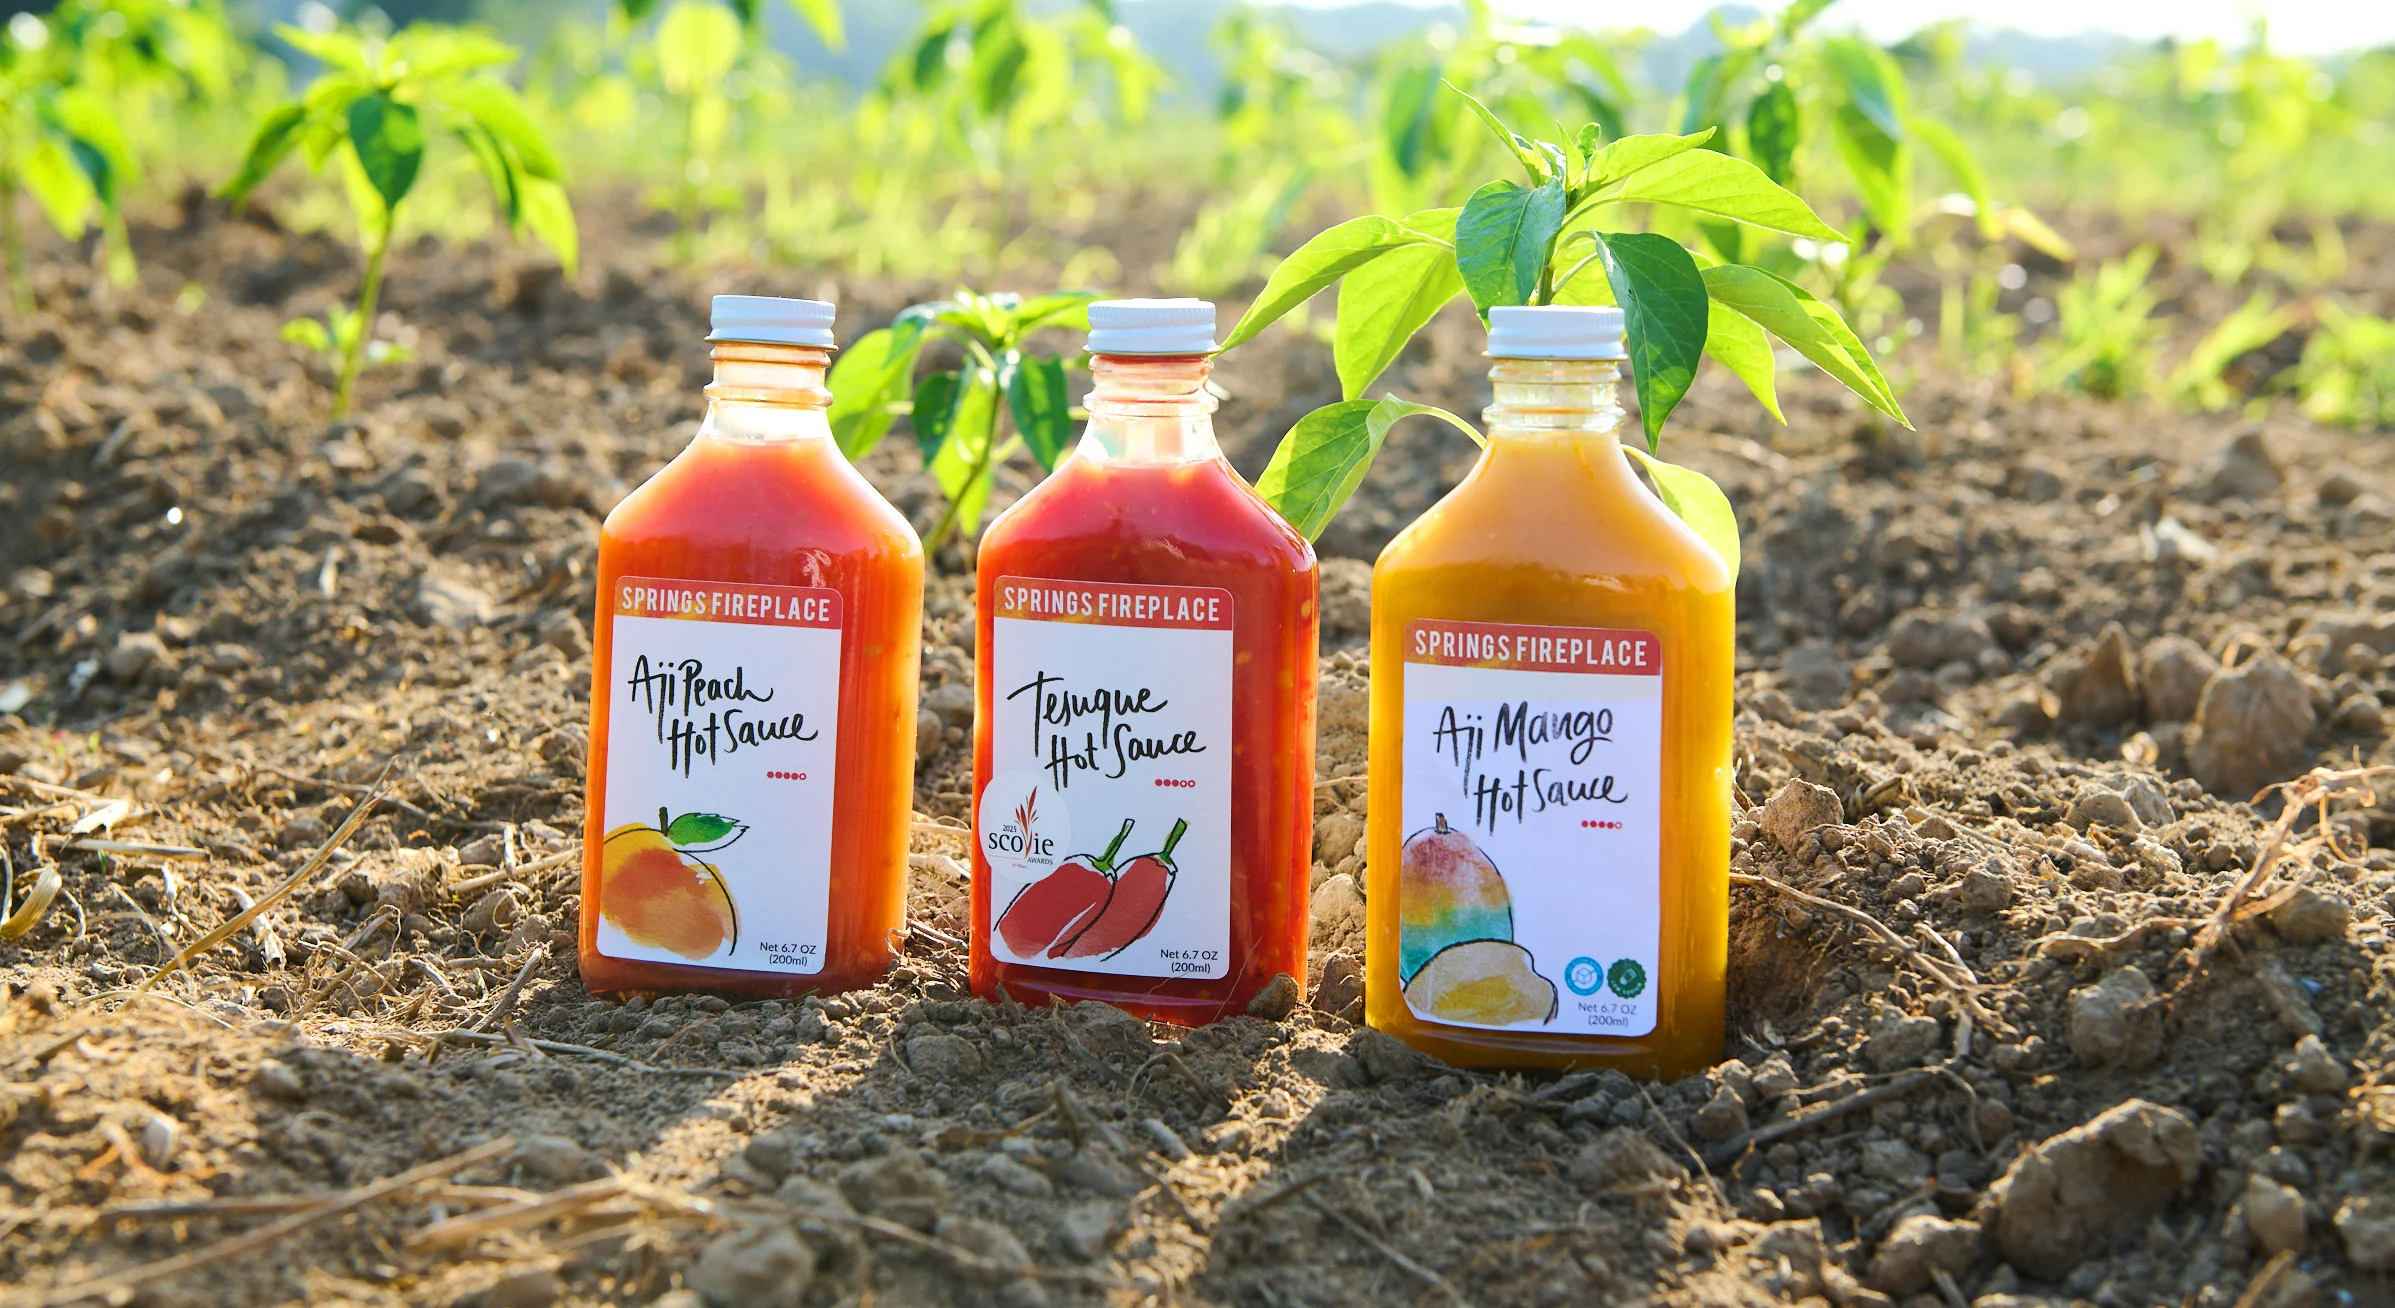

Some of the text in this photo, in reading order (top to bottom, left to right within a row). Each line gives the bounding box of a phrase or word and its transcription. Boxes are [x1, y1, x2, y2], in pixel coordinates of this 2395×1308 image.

[622, 586, 831, 623] SPRINGS FIREPLACE
[1004, 586, 1220, 623] SPRINGS FIREPLACE
[1415, 629, 1648, 667] SPRINGS FIREPLACE
[628, 654, 774, 744] Aji Peach
[1007, 671, 1168, 758] Tesuque
[667, 708, 818, 778] Hot Sauce
[1044, 723, 1207, 792] Hot Sauce
[1433, 701, 1614, 799] Aji Mango
[1473, 768, 1628, 836] Hot Sauce
[1027, 857, 1054, 866] AWARDS
[760, 941, 817, 955] Net 6.7 OZ
[769, 954, 808, 967] (200ml)
[1160, 949, 1218, 961] Net 6.7 OZ
[1171, 962, 1211, 974] (200ml)
[1578, 1002, 1637, 1015] Net 6.7 OZ
[1588, 1015, 1629, 1028] (200ml)
